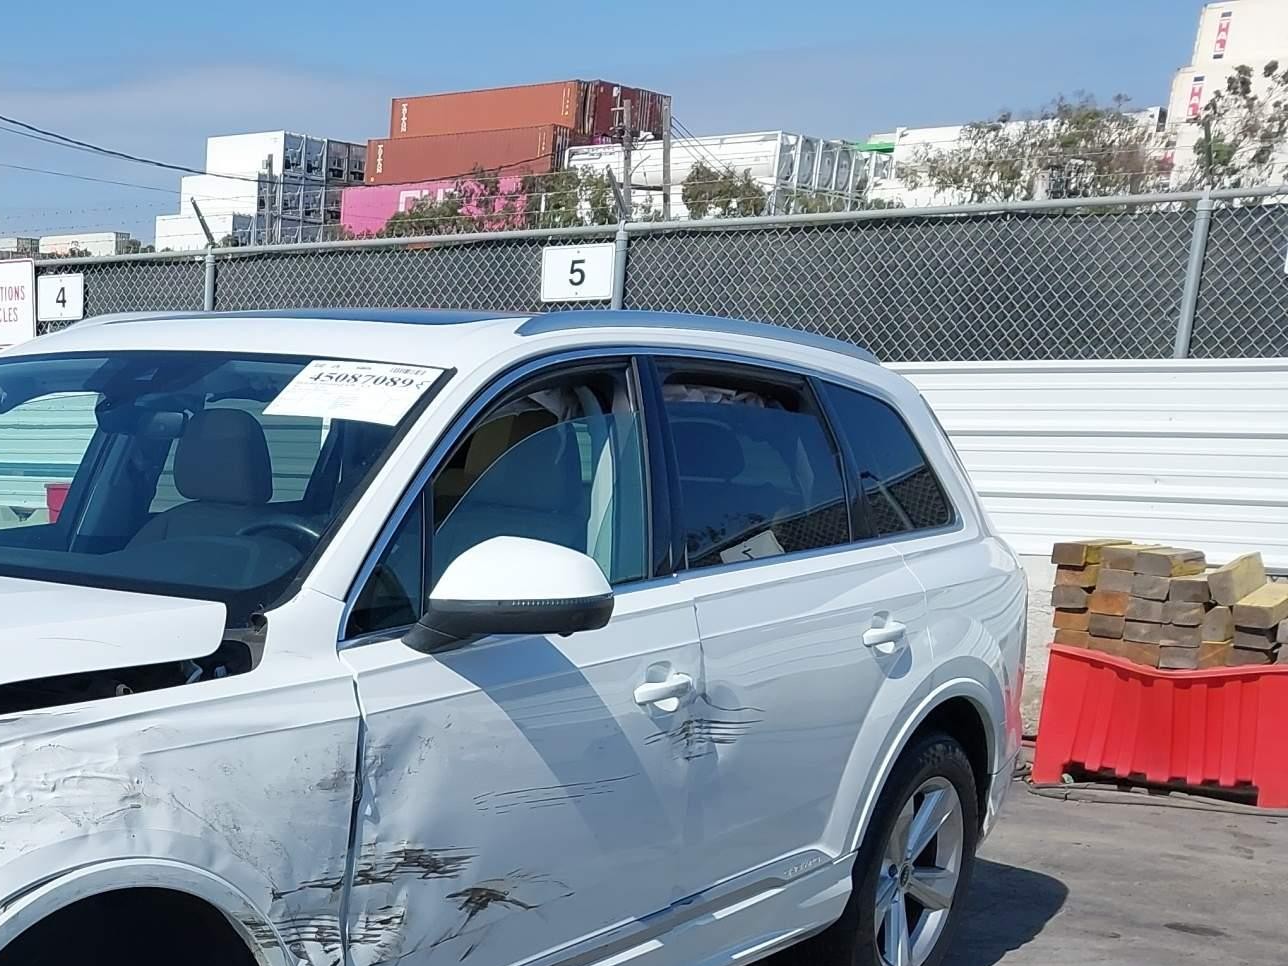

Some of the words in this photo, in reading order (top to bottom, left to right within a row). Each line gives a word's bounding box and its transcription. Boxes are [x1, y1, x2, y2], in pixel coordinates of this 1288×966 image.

[1214, 20, 1230, 51] TAL
[568, 258, 586, 287] 5
[55, 286, 67, 308] 4
[309, 371, 415, 388] 45087089
